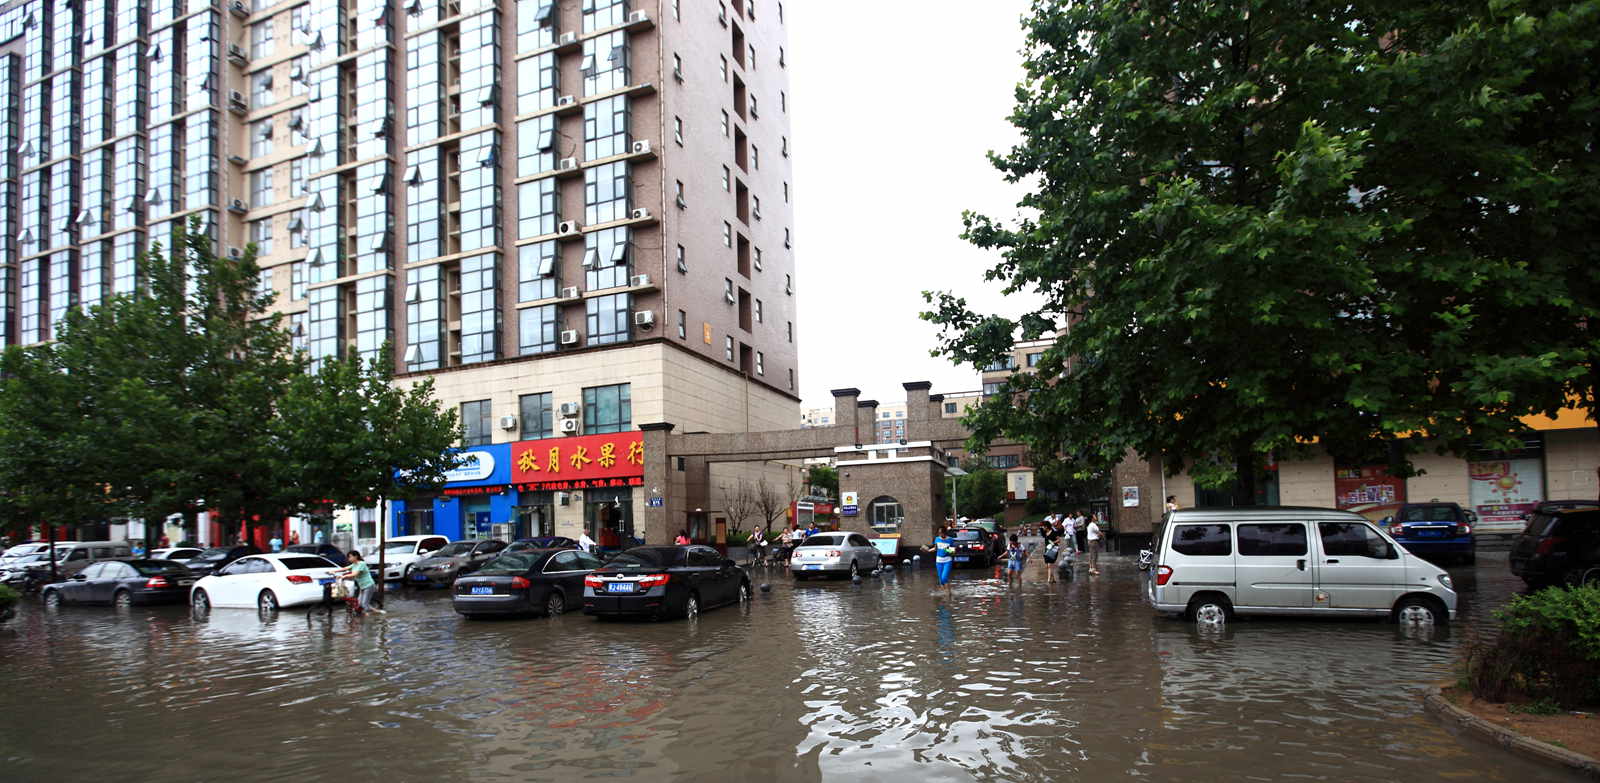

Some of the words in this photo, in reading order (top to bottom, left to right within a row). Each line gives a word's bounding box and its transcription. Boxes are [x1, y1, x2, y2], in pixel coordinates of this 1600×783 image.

[517, 440, 644, 473] 秋月水果行
